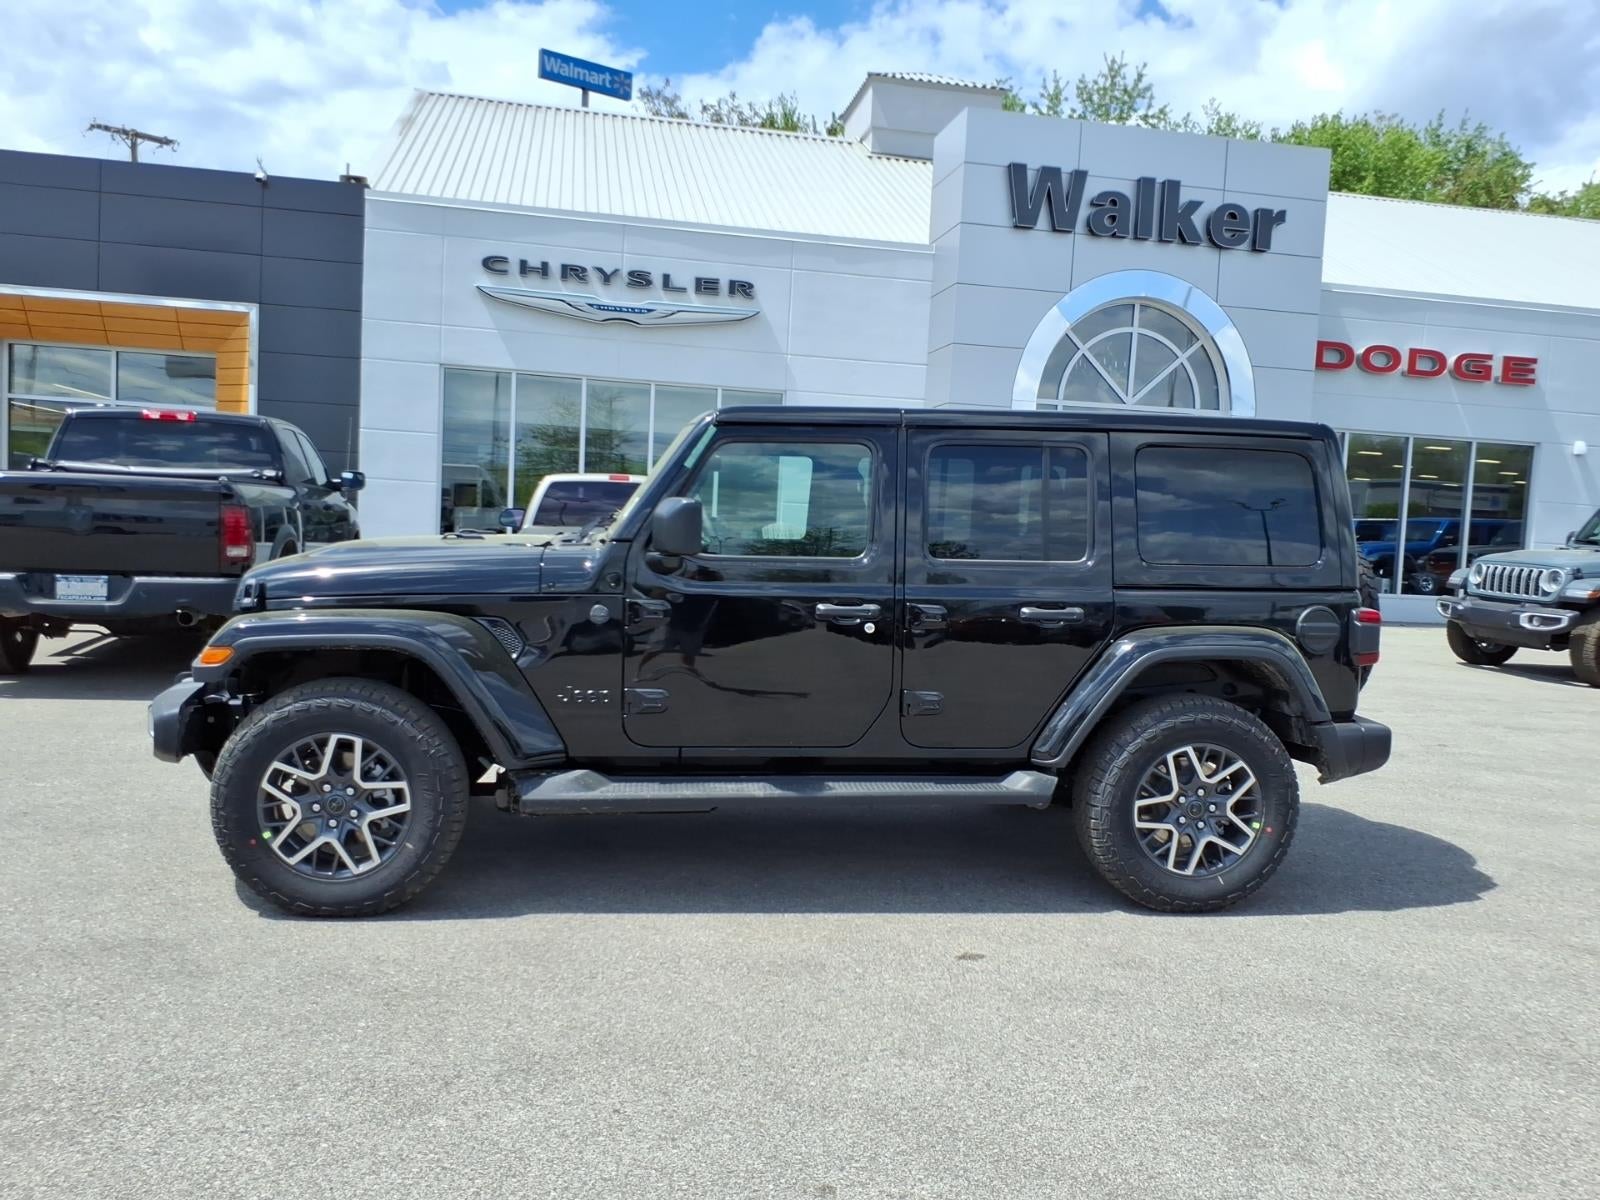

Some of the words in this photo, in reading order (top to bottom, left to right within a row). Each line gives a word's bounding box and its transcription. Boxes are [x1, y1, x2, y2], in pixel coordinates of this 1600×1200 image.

[543, 55, 612, 88] Walmart
[1008, 162, 1286, 252] Walker
[481, 255, 756, 299] CHRYSLER
[1315, 340, 1538, 385] DODGE
